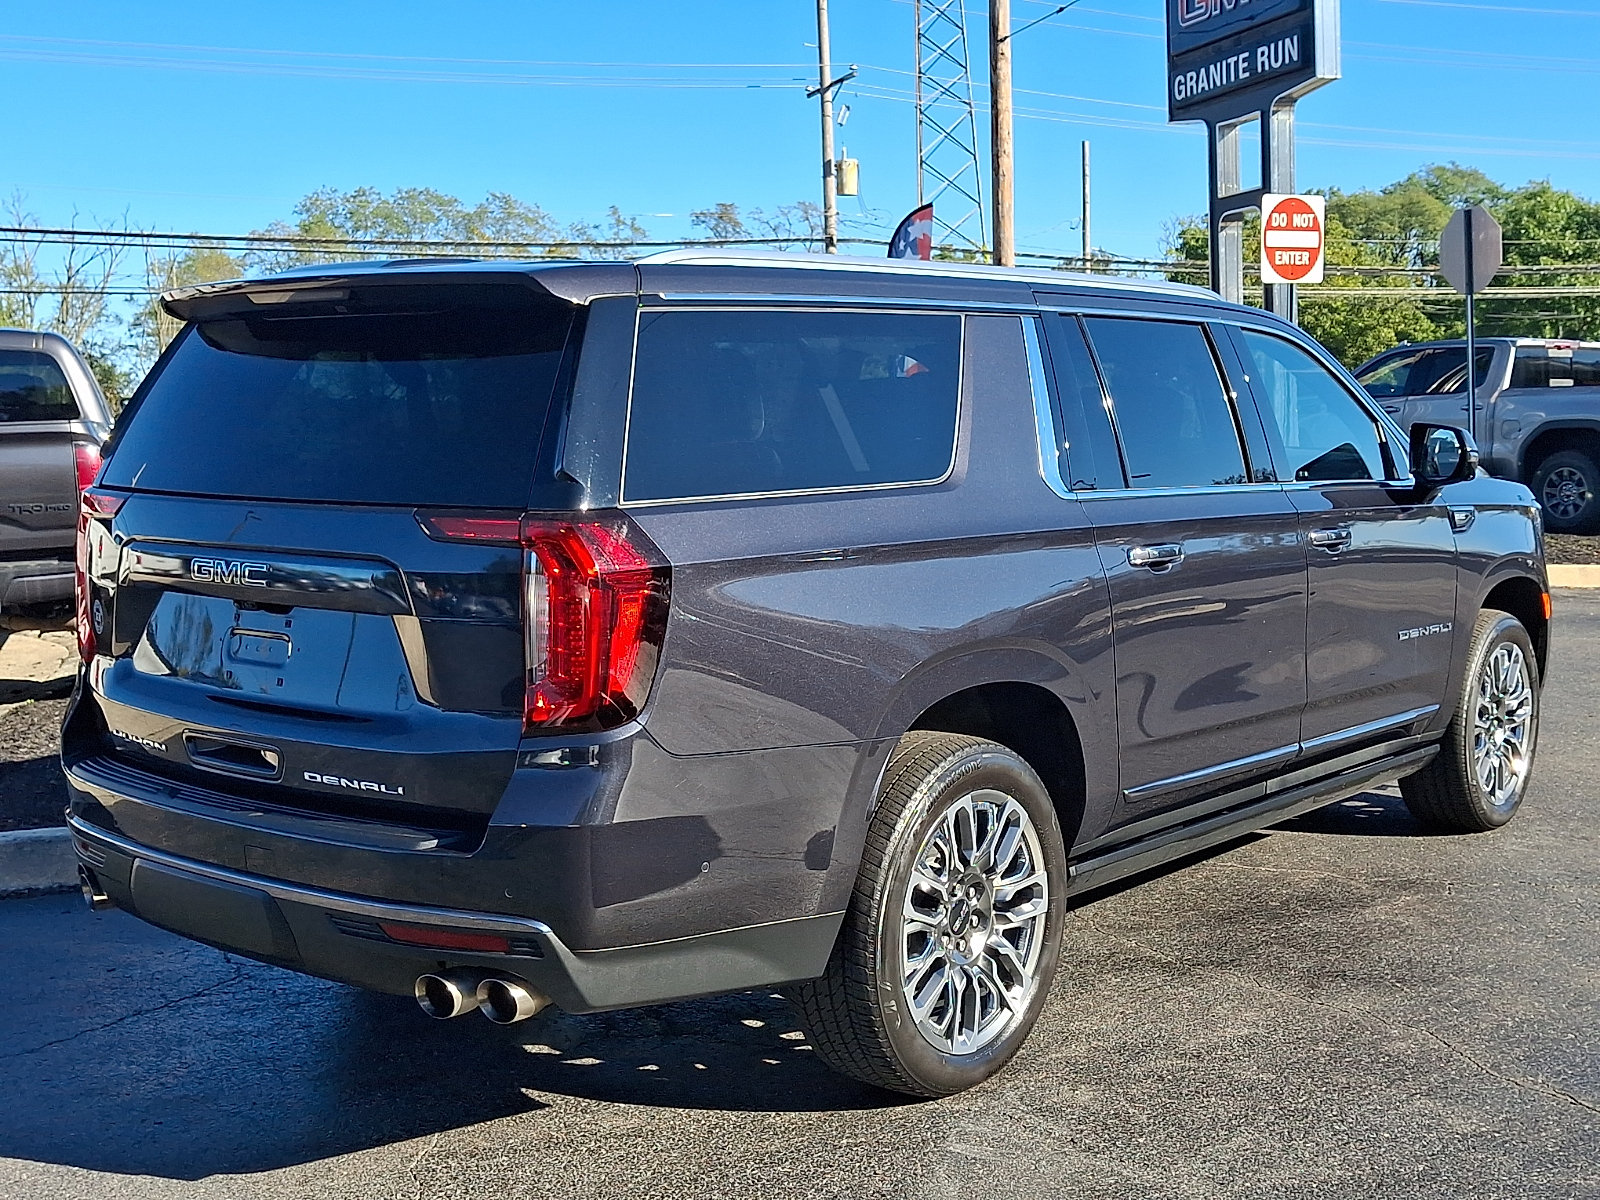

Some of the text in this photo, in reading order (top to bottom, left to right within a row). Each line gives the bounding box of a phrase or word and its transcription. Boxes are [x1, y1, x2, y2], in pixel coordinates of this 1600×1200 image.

[1174, 34, 1299, 101] GRANITE RUN
[1271, 212, 1315, 228] DO NOT
[1274, 250, 1310, 266] ENTER
[190, 557, 268, 588] GMC
[1398, 622, 1452, 641] DENALI
[303, 770, 404, 796] DENALI
